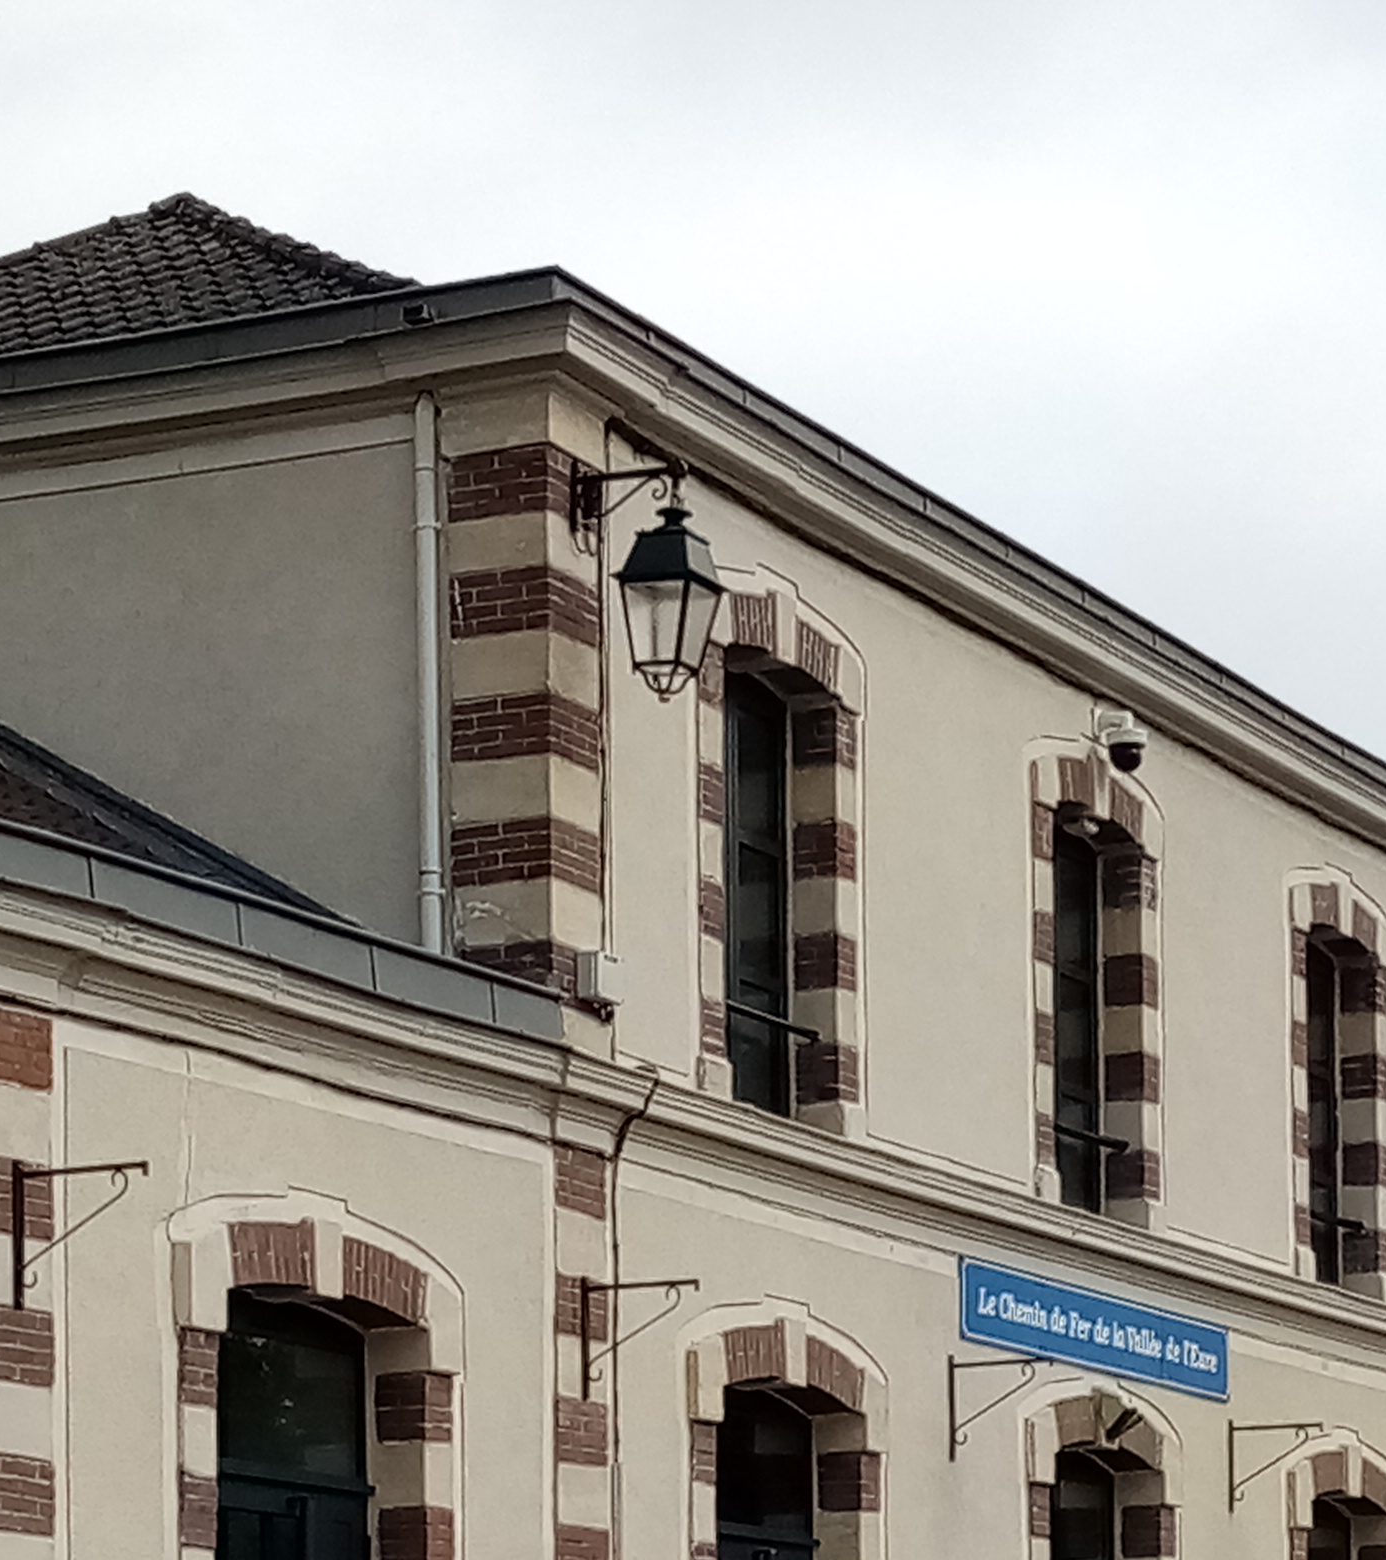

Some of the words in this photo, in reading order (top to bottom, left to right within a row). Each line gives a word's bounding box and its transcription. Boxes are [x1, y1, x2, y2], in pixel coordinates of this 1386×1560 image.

[978, 1287, 996, 1316] Le
[999, 1292, 1047, 1330] Chemin
[1051, 1305, 1067, 1334] de
[1069, 1311, 1092, 1341] Fer
[1094, 1316, 1109, 1345] de
[1113, 1321, 1126, 1350] la
[1125, 1325, 1162, 1358] Vallée
[1166, 1336, 1180, 1363] de
[1183, 1340, 1218, 1373] l'Eure
